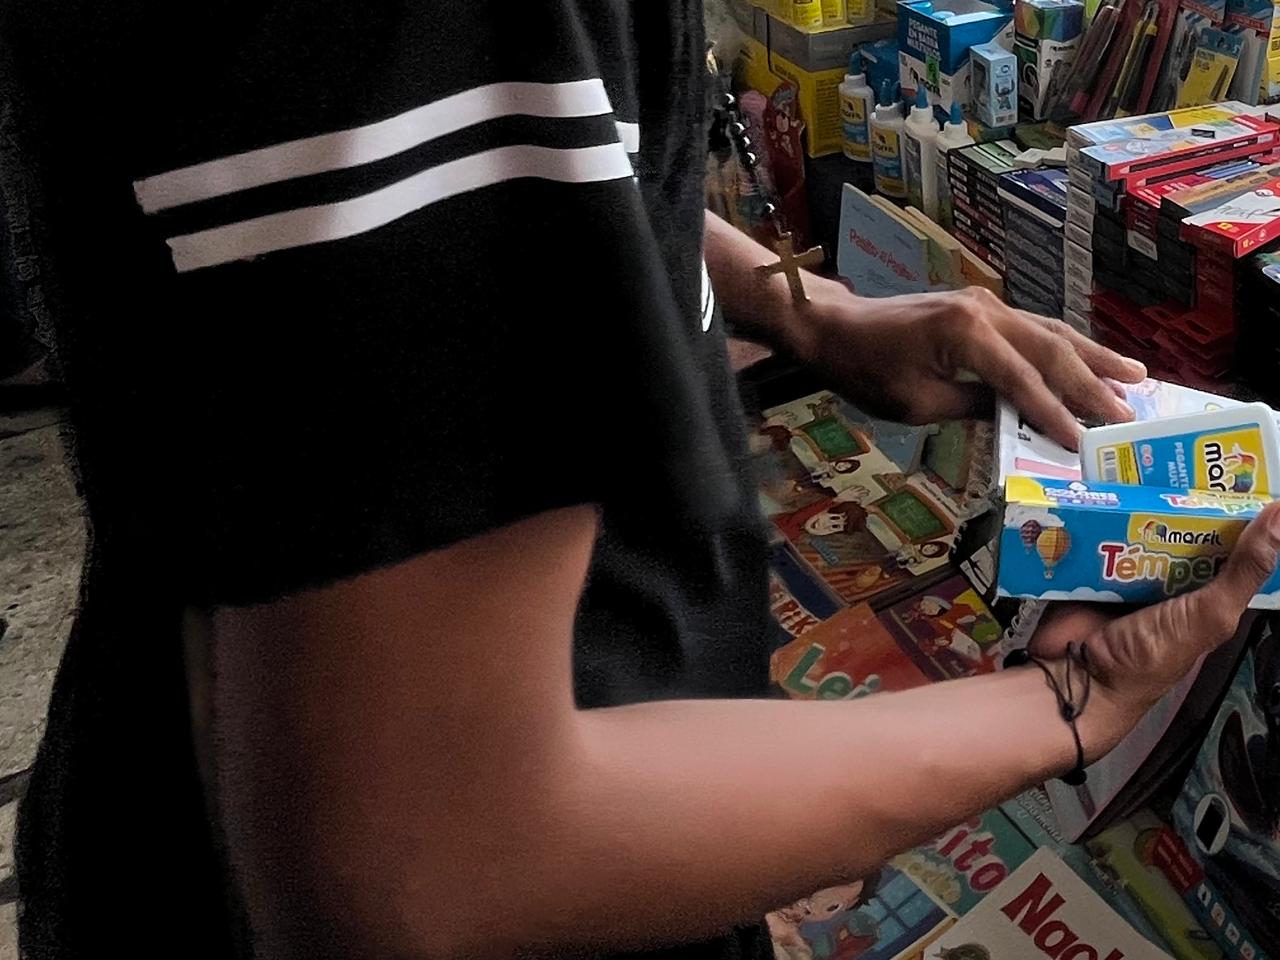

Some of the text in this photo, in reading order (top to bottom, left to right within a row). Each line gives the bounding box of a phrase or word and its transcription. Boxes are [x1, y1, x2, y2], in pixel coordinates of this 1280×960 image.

[1174, 441, 1190, 489] PEGANTE
[1204, 442, 1226, 492] mar
[1167, 529, 1222, 546] marfil
[1099, 541, 1229, 595] Témper
[1000, 871, 1126, 960] Nac
